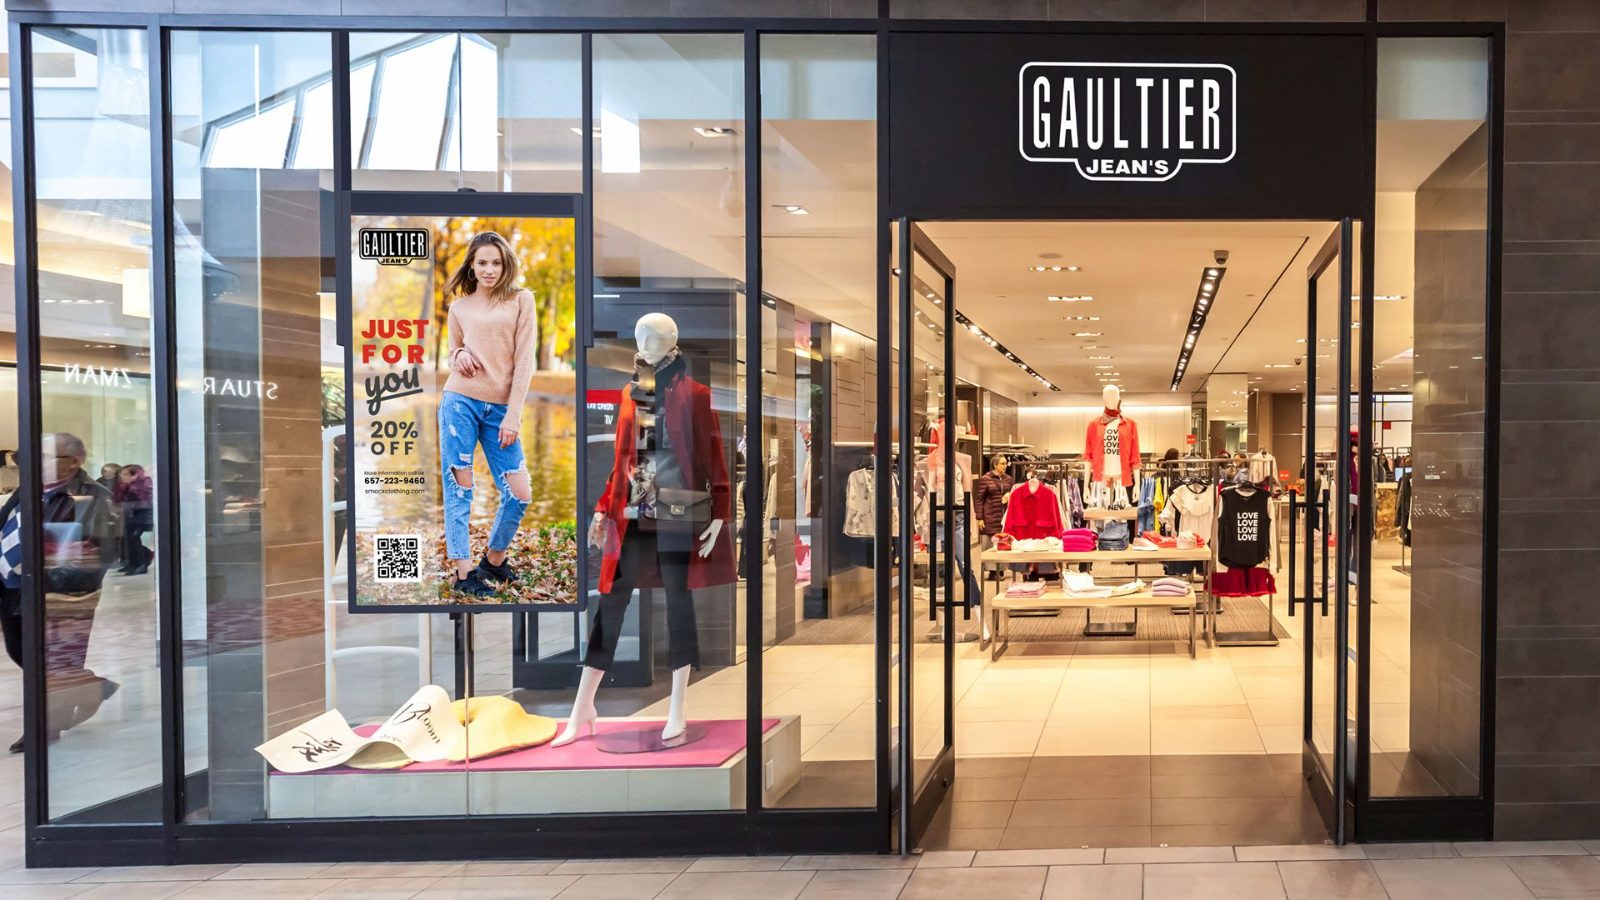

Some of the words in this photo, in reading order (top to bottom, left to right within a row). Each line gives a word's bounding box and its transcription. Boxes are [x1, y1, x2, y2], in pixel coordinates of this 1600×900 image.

[1033, 75, 1220, 150] GAULTIER
[1086, 159, 1169, 175] JEAN'S
[363, 232, 425, 256] GAULTIER
[361, 319, 429, 339] JUST
[362, 344, 425, 364] FOR
[365, 367, 423, 416] you
[370, 420, 419, 439] 20%
[370, 441, 415, 455] OFF
[364, 477, 425, 485] 657-223-9460
[1107, 503, 1126, 511] NEW
[1237, 519, 1258, 527] LOVE
[1237, 526, 1258, 534] LOVE
[1237, 533, 1258, 541] LOVE
